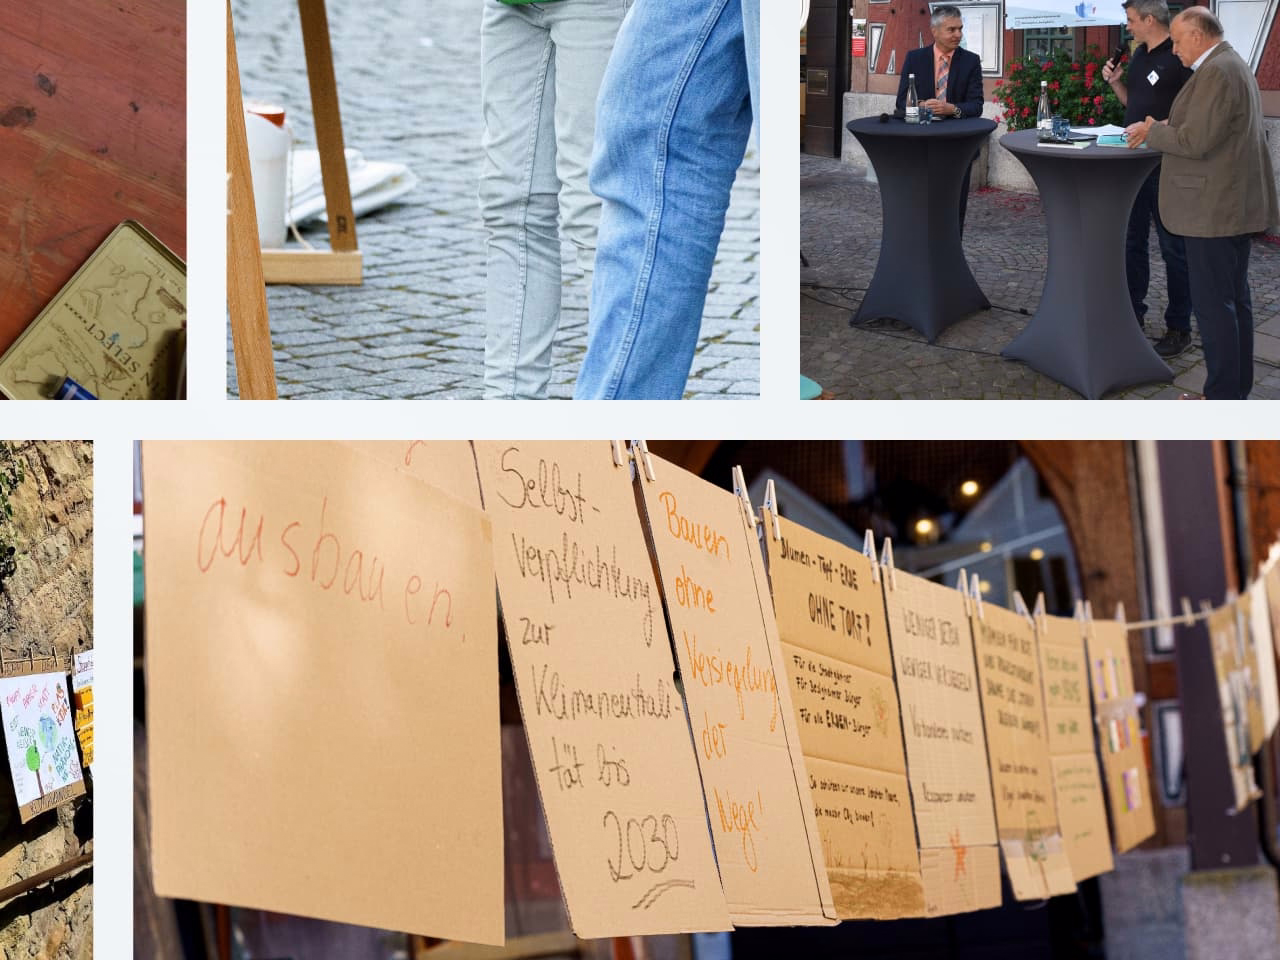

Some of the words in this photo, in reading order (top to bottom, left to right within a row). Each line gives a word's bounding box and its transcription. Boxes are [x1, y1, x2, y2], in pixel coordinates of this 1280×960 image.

[658, 490, 731, 561] Bauen
[674, 564, 717, 615] ohne
[808, 592, 837, 632] OHNE
[702, 711, 729, 761] der
[548, 735, 585, 792] tät
[596, 742, 631, 788] bis
[602, 809, 680, 883] 2030
